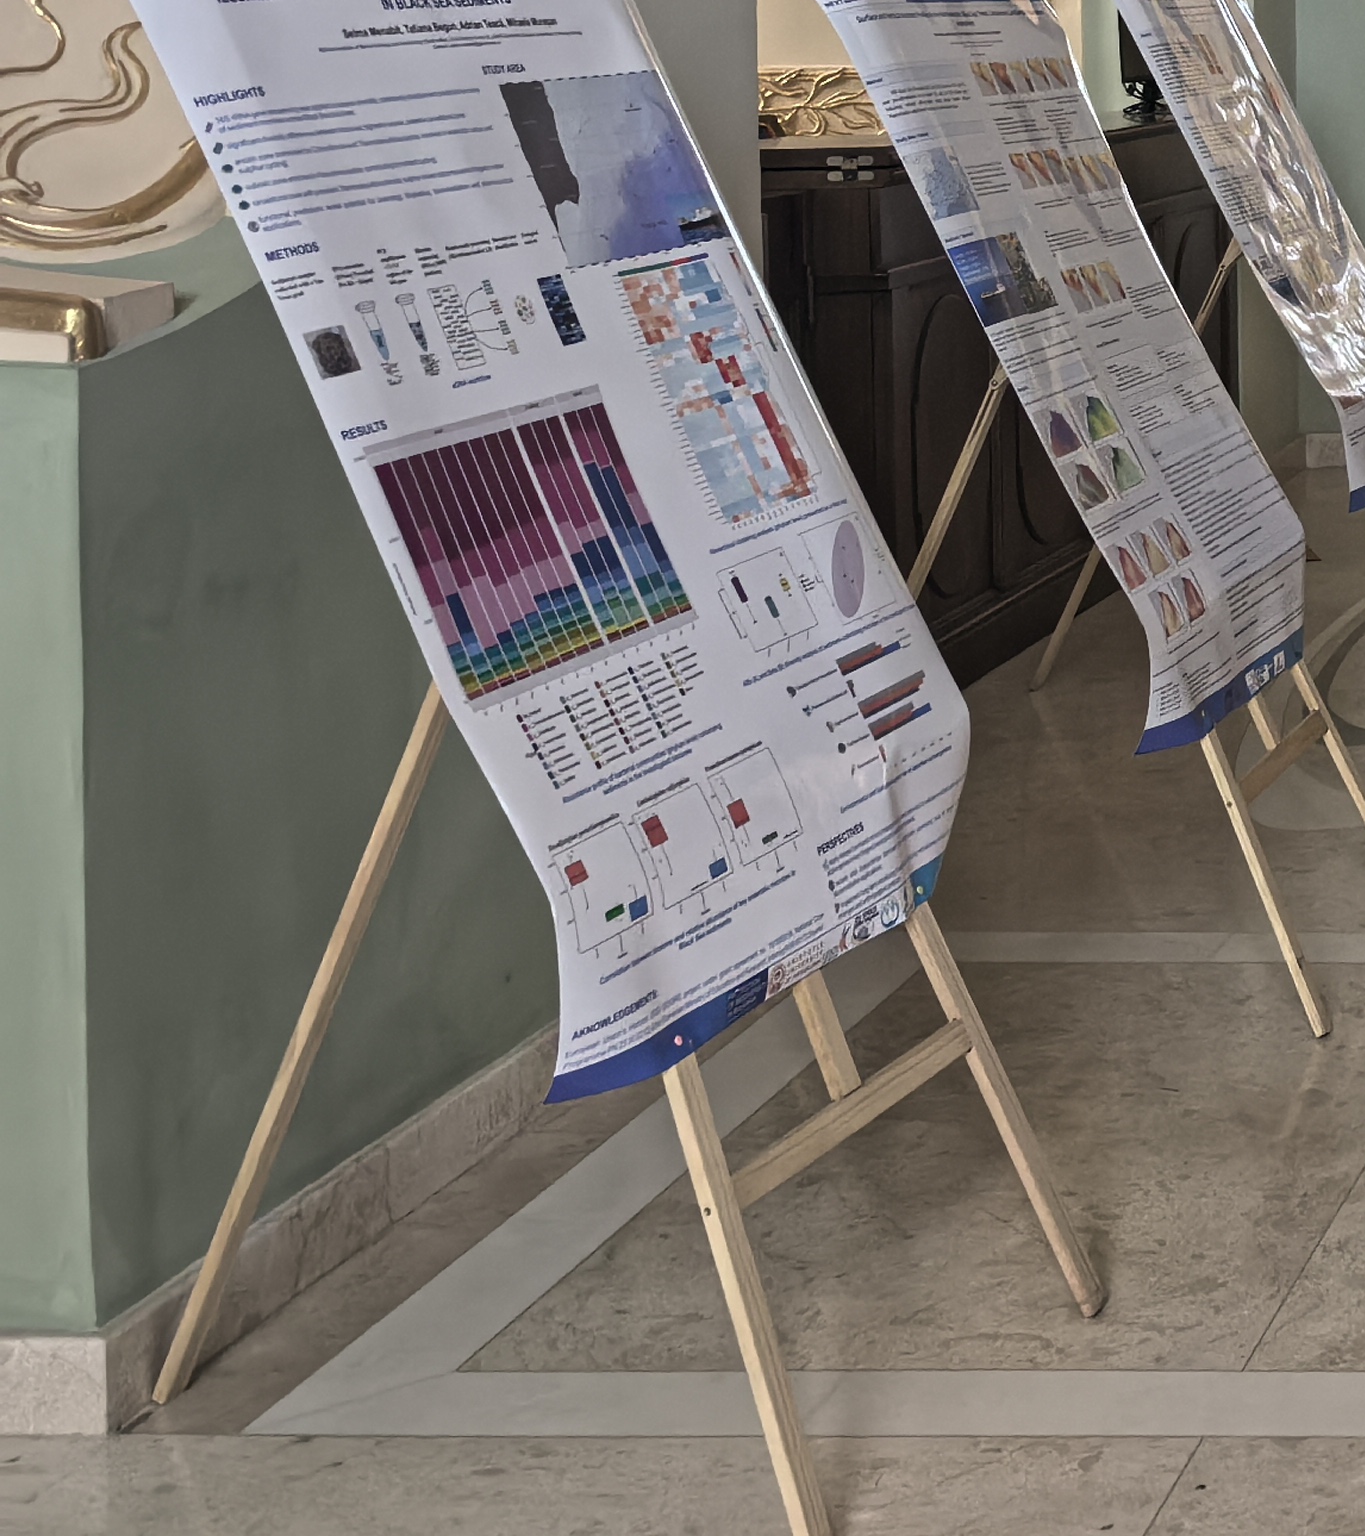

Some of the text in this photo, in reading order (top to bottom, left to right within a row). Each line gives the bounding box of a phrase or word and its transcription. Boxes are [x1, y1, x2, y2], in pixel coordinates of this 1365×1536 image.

[194, 86, 266, 107] HIGHLIGHTS
[265, 242, 320, 262] METHODS
[340, 420, 388, 441] RESULTS
[817, 822, 865, 856] PERSPECTIVES
